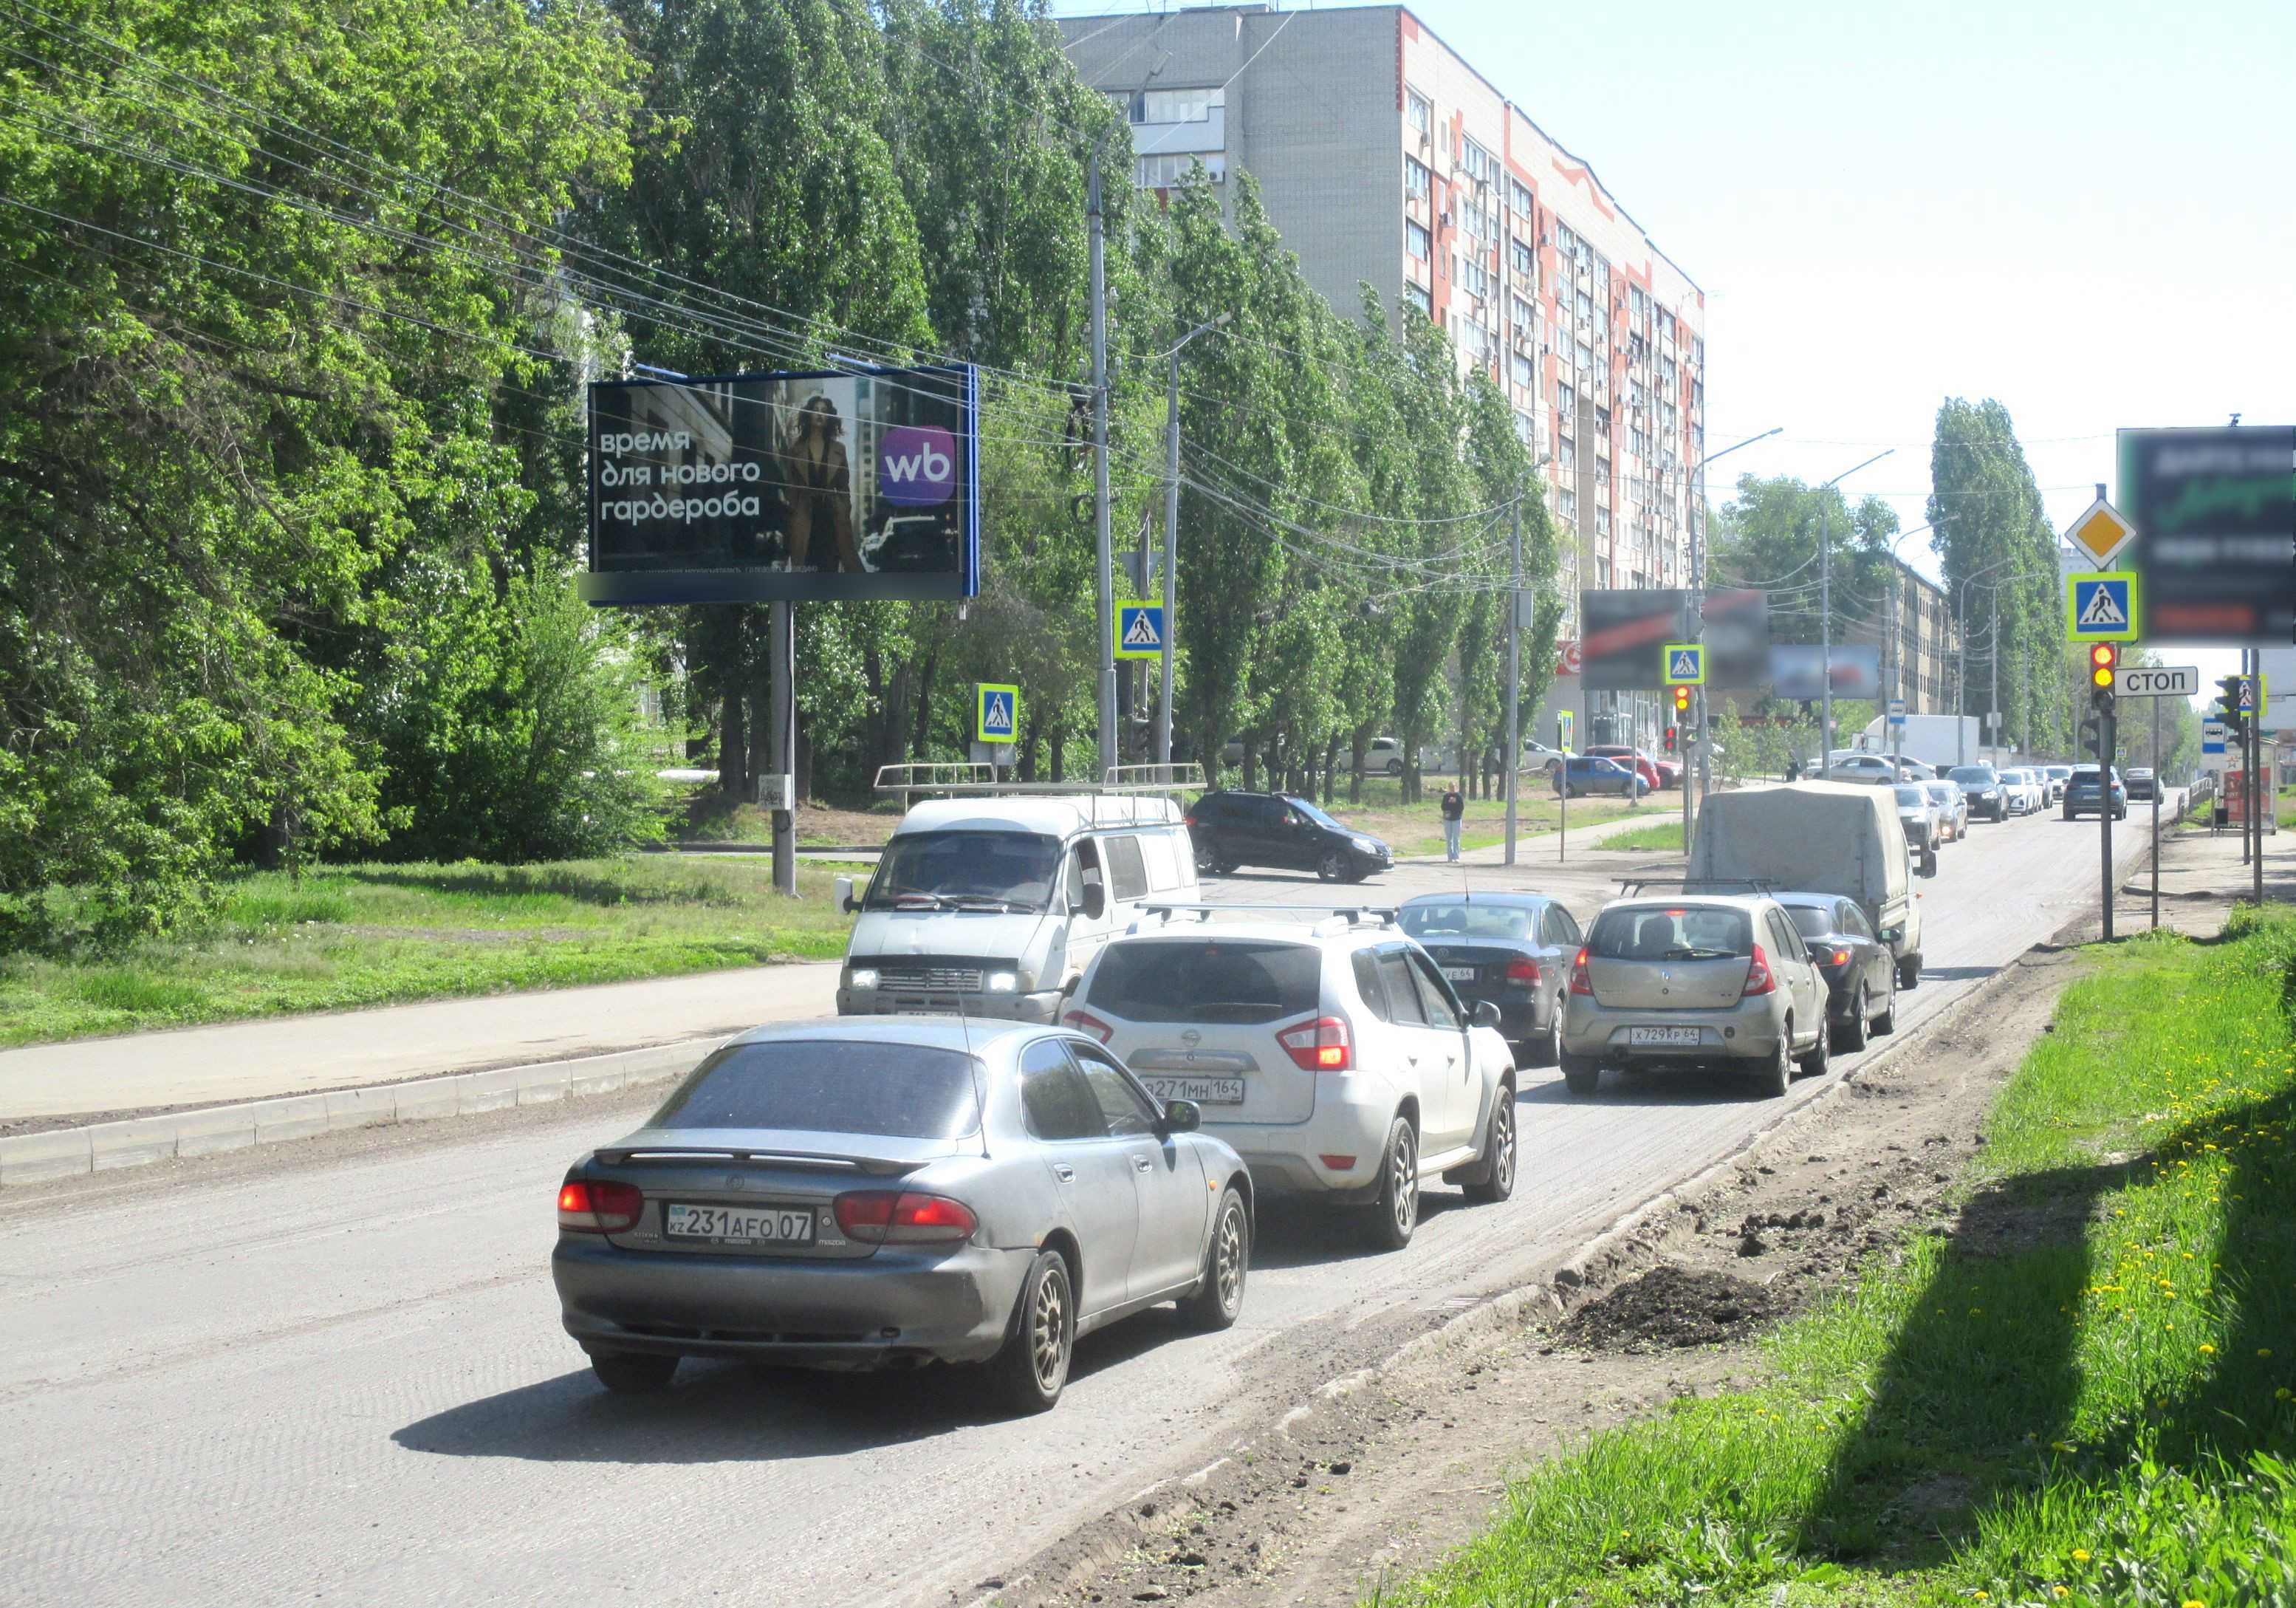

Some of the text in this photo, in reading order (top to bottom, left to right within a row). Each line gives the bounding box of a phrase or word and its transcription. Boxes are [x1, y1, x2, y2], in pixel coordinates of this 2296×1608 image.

[600, 431, 690, 459] время
[601, 459, 761, 487] для нового
[884, 442, 950, 482] wb
[601, 490, 760, 526] гардероба
[2126, 671, 2185, 691] СТОП
[1213, 1081, 1240, 1094] 164
[669, 1222, 685, 1233] KZ
[780, 1214, 809, 1240] 07
